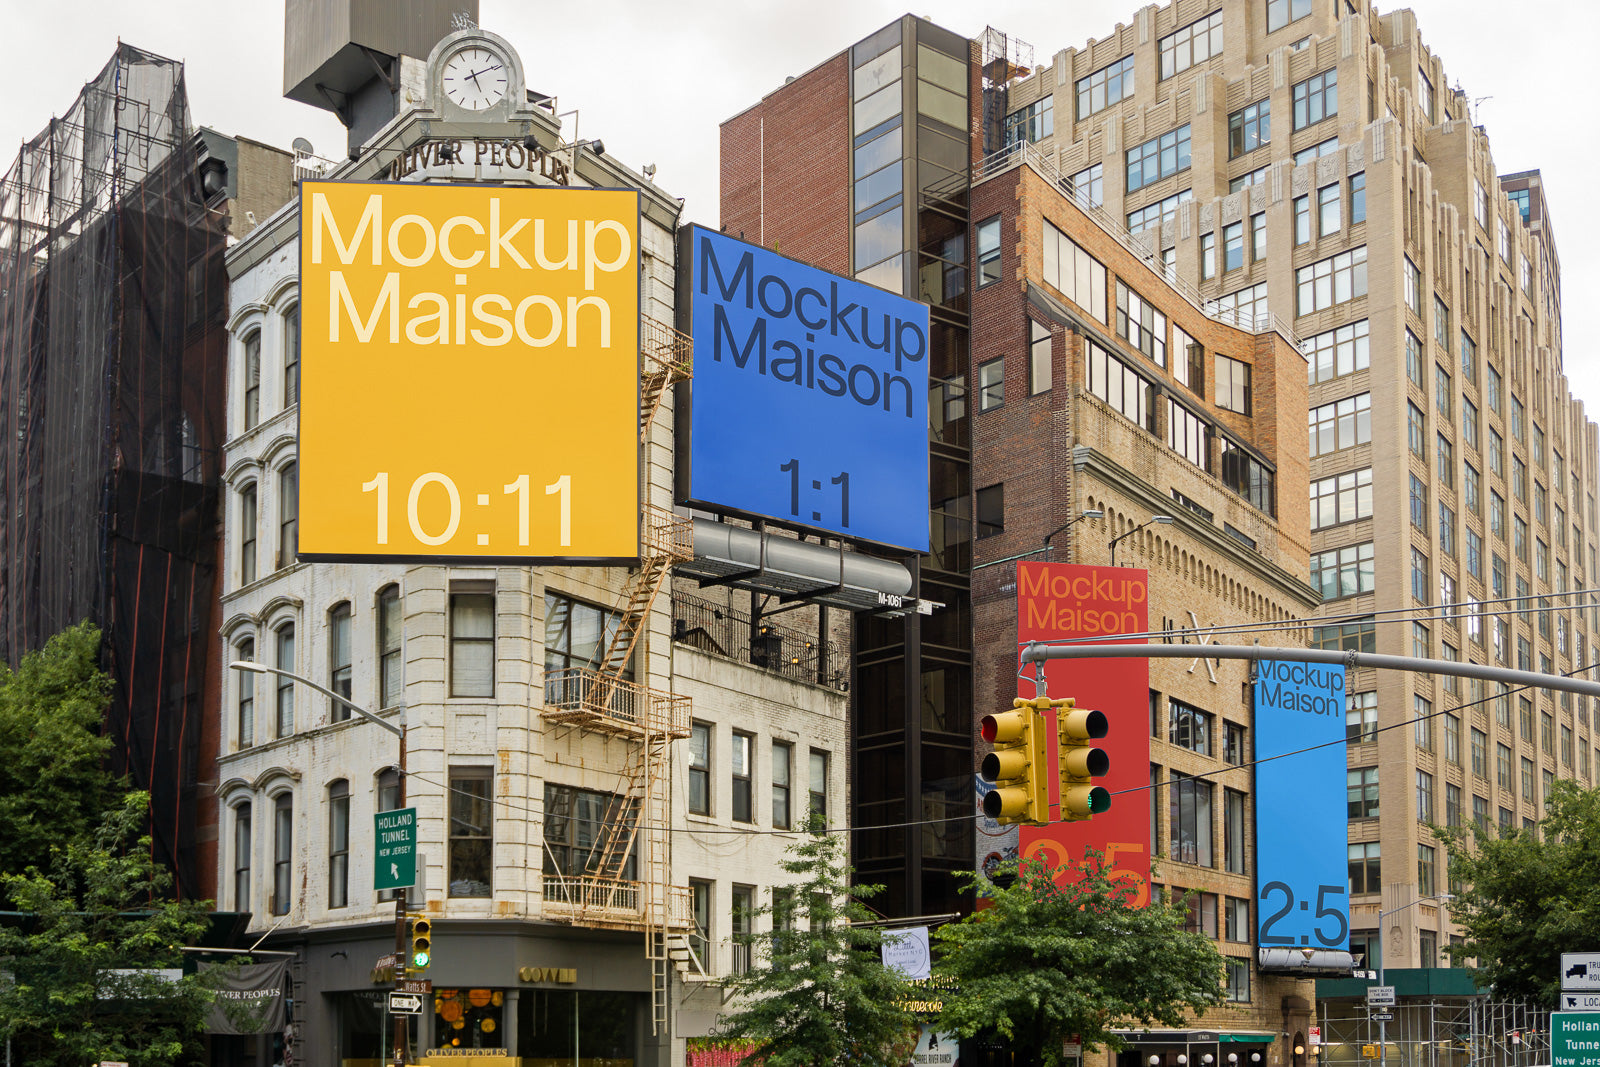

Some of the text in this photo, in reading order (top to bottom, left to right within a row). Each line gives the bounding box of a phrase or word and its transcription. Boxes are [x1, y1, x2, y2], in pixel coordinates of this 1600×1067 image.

[390, 140, 570, 186] OLIVER PEOPLES
[312, 193, 632, 291] Mockup
[330, 270, 611, 348] Maison
[700, 236, 927, 372] Mockup
[713, 303, 913, 419] Maison
[780, 458, 850, 529] 1:1
[362, 471, 571, 547] 10:11
[878, 592, 902, 608] M-1061
[1020, 566, 1146, 610] Mockup
[1027, 599, 1139, 634] Maison
[1258, 660, 1345, 698] Mockup
[1261, 679, 1340, 718] Maison
[378, 813, 412, 829] HOLLAND
[381, 829, 410, 843] TUNNEL
[379, 845, 412, 857] NEW JERSEY
[1258, 880, 1348, 947] 2:5
[243, 987, 281, 1000] PEOPLES
[405, 981, 420, 993] Watts
[394, 999, 404, 1007] ONE
[1583, 997, 1600, 1007] LOC
[1562, 1020, 1600, 1032] Hollan
[425, 1048, 508, 1057] OLIVER PEOPLES
[1565, 1039, 1600, 1051] Tunne
[1555, 1056, 1576, 1066] New
